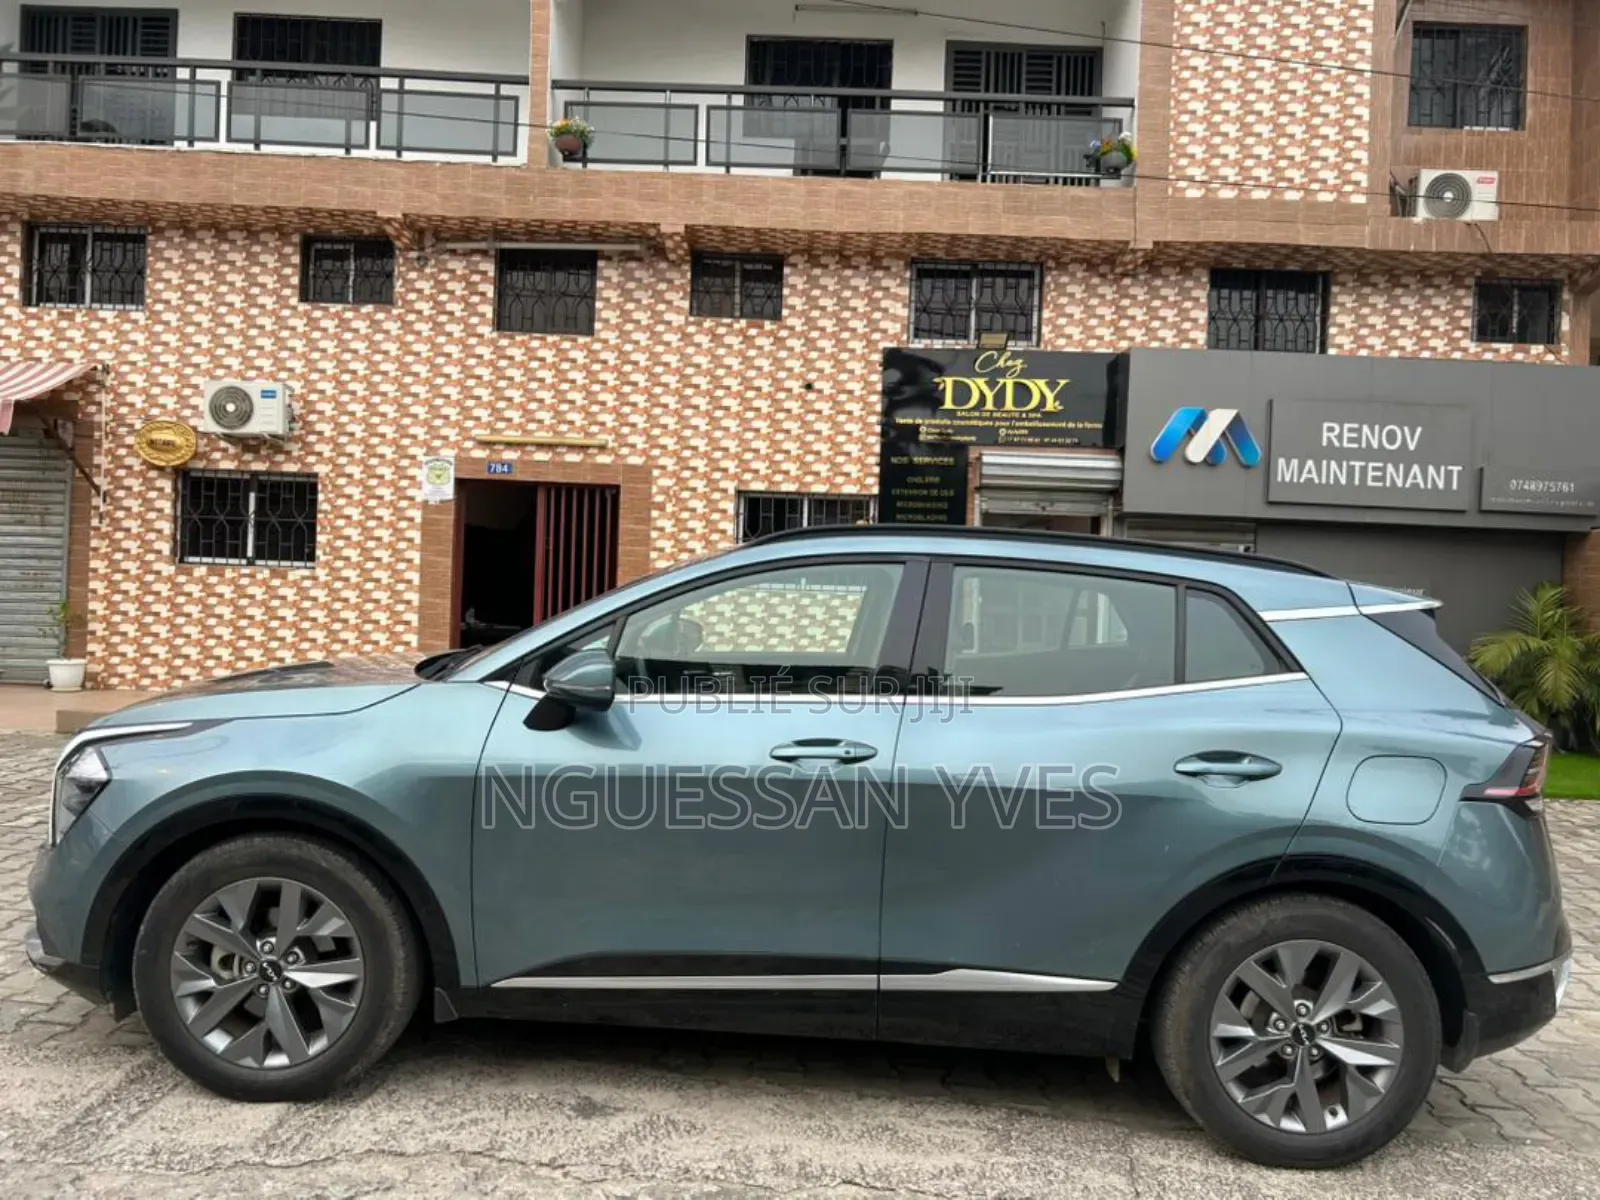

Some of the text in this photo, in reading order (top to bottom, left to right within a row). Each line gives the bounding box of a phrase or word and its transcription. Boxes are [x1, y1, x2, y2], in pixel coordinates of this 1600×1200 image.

[974, 350, 1027, 378] Chez
[935, 376, 1070, 412] DYDY
[1321, 421, 1423, 452] RENOV
[490, 463, 509, 473] 784
[890, 456, 955, 466] NOS SERVICES
[1276, 457, 1464, 492] MAINTENANT
